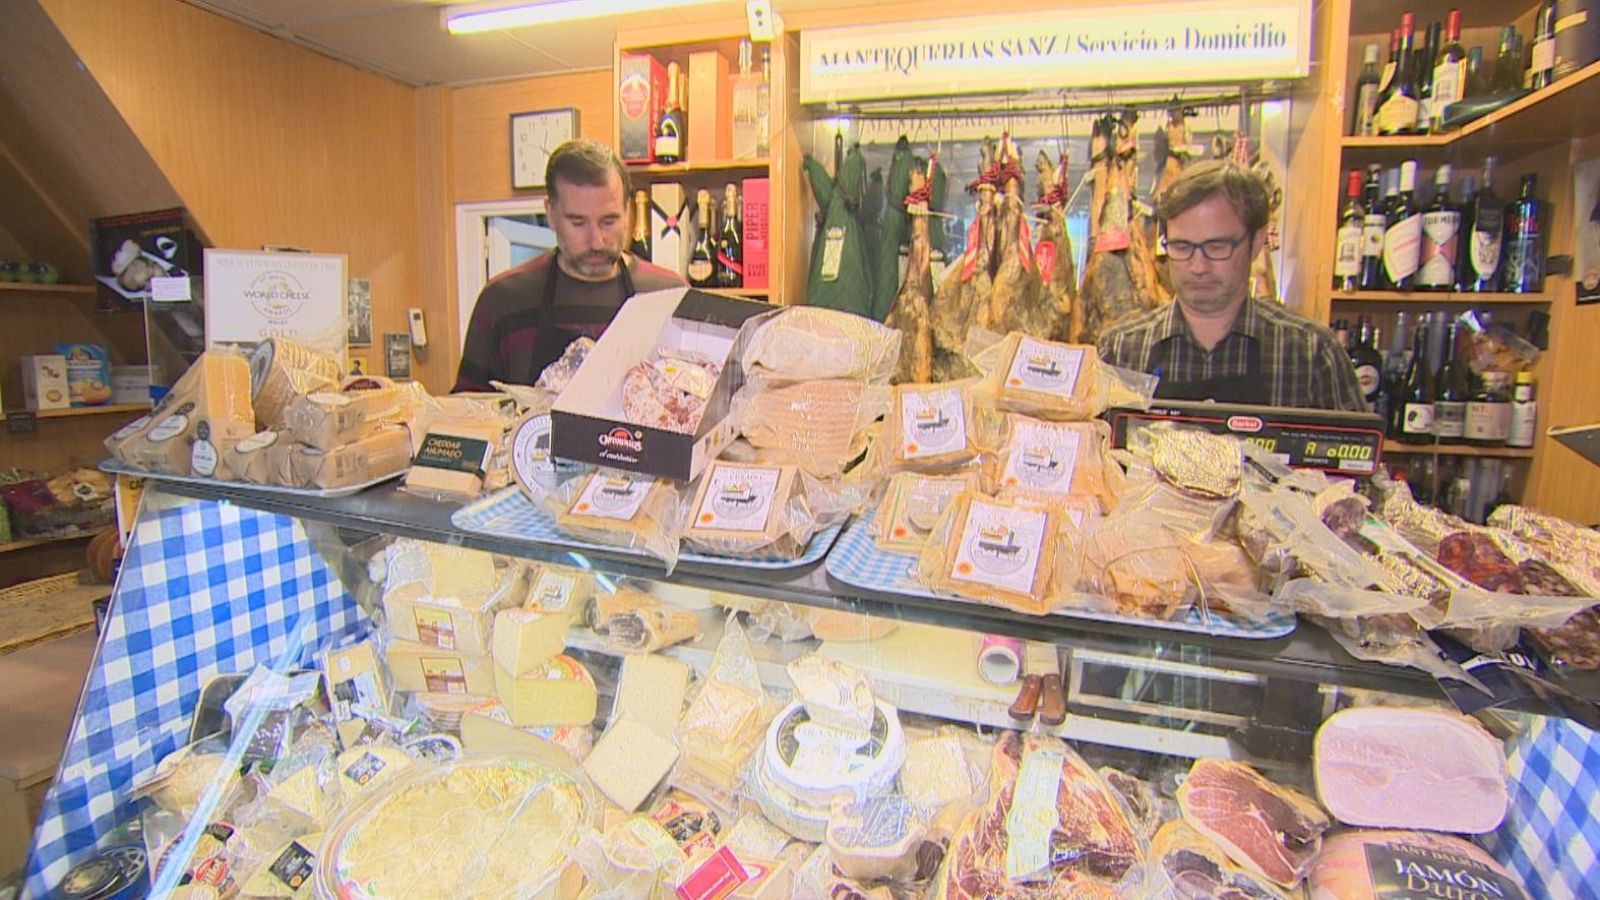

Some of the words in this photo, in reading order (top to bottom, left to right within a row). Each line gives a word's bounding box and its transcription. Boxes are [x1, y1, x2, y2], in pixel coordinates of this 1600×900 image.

[819, 41, 994, 75] MANTEQUERIAS
[1000, 34, 1058, 57] SANZ
[1076, 29, 1158, 53] Servicio
[1164, 36, 1176, 50] a
[1184, 22, 1287, 49] Domicilio
[745, 202, 760, 241] PIPER
[244, 288, 279, 300] WORLD
[280, 288, 311, 300] CHEESE
[424, 446, 462, 459] AHUMADO
[428, 438, 461, 450] CHEDDAR
[1393, 857, 1504, 897] JAMÓN
